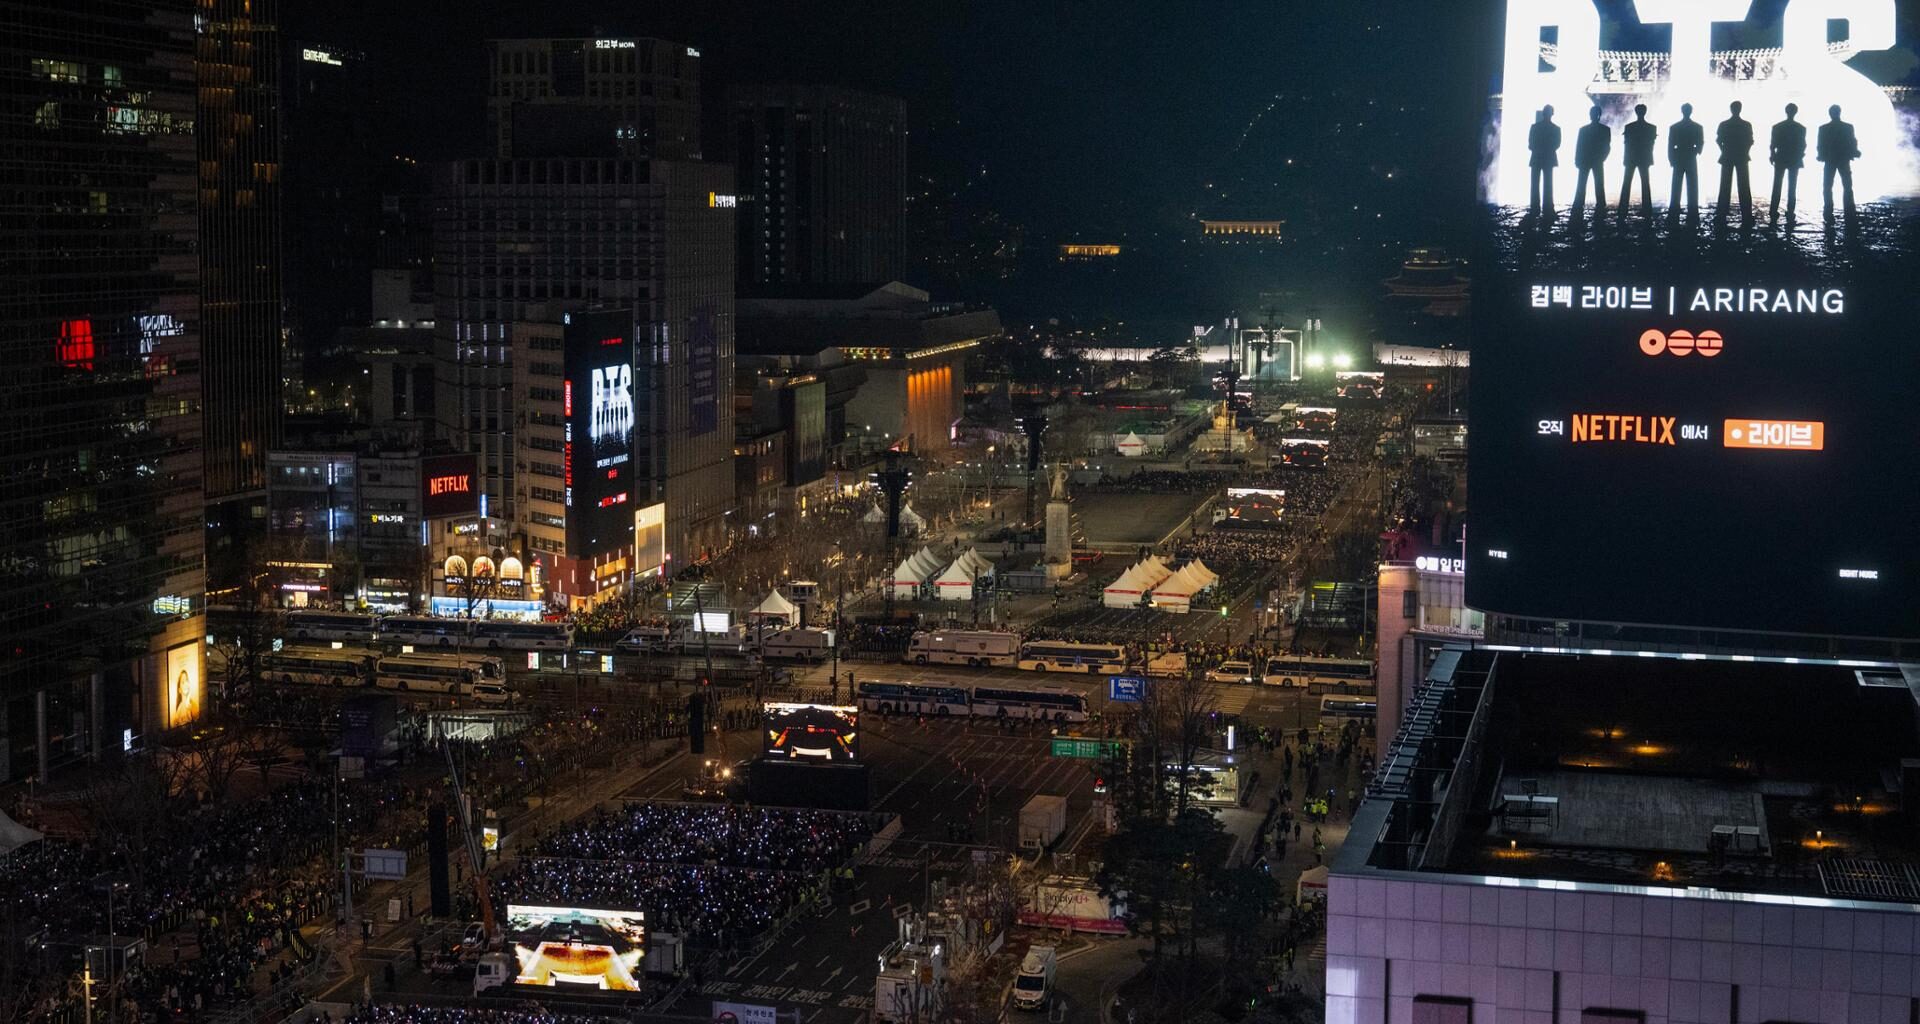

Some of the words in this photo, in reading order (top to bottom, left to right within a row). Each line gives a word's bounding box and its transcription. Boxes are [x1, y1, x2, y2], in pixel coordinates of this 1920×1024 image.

[596, 40, 618, 48] 외교부
[1531, 285, 1572, 308] 컴백
[1582, 286, 1653, 309] 라이브
[1690, 288, 1844, 314] ARIRANG
[1538, 420, 1563, 435] 오직
[1572, 414, 1676, 445] NETFLIX
[1681, 424, 1708, 440] 에서
[1748, 422, 1813, 446] 라이브
[430, 475, 468, 496] NETFLIX
